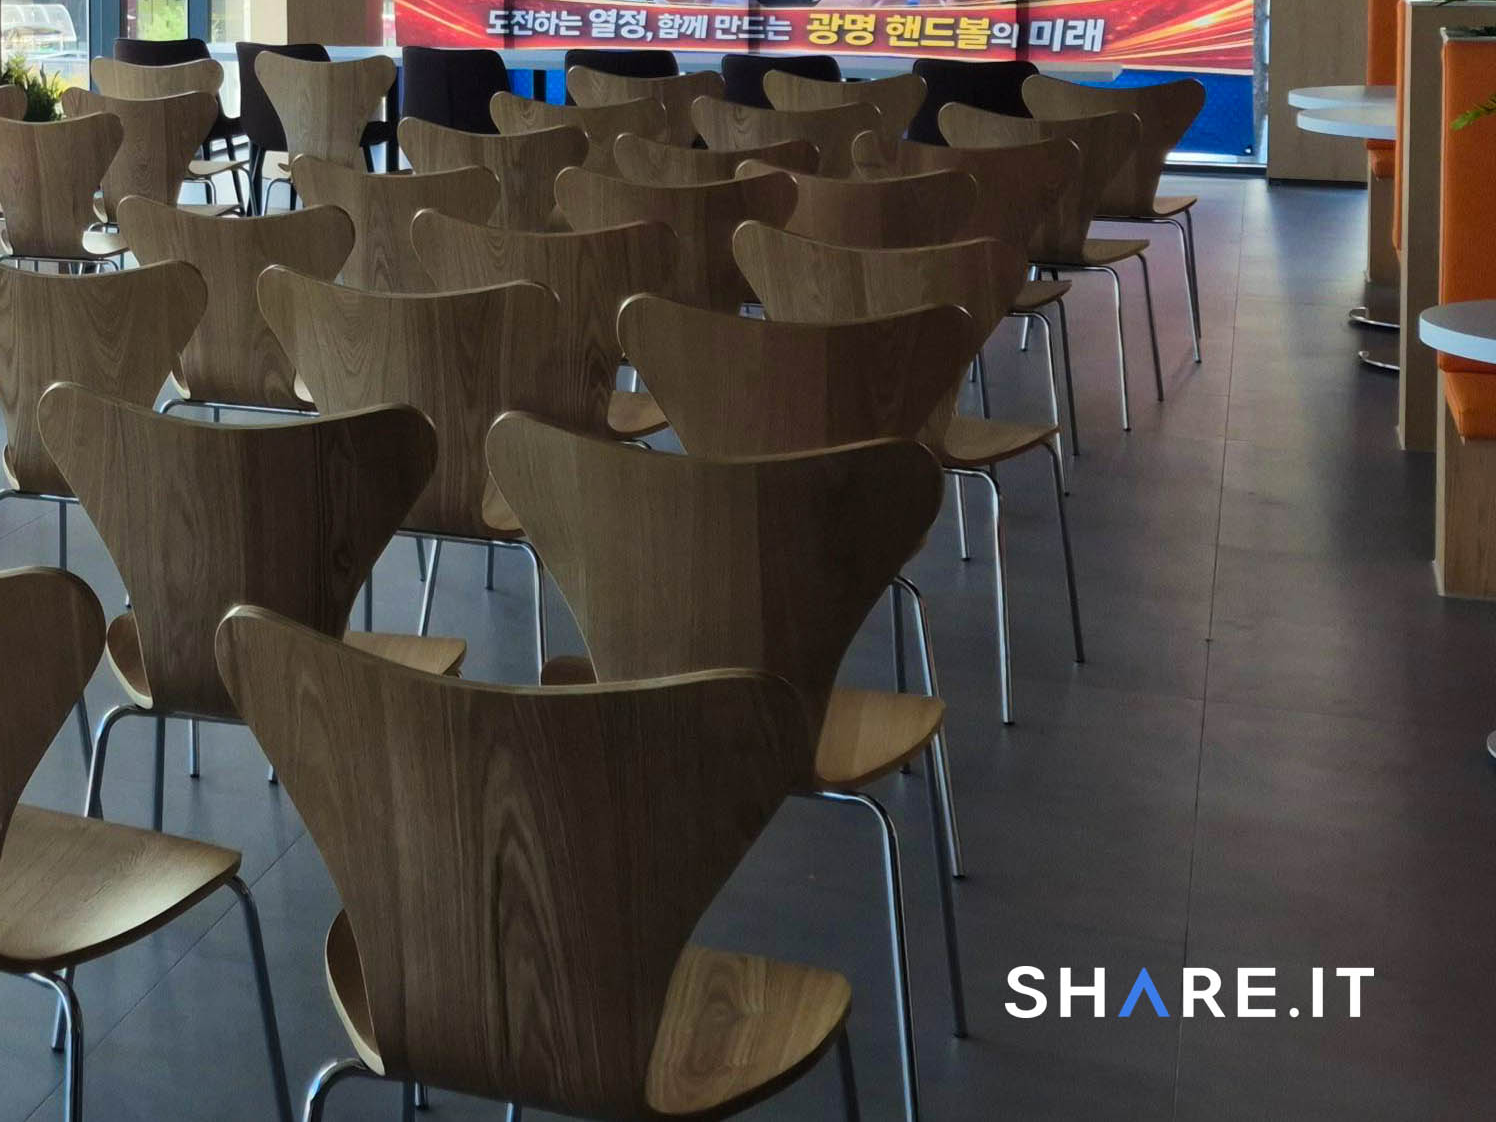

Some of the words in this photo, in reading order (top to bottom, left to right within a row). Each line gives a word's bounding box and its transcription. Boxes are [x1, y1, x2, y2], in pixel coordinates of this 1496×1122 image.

[486, 9, 582, 36] 도전하는
[589, 8, 654, 42] 열정,
[657, 13, 708, 39] 함께
[714, 15, 792, 41] 만드는
[806, 13, 877, 46] 광명
[885, 14, 1019, 50] 핸드볼의
[1027, 18, 1105, 52] 미래
